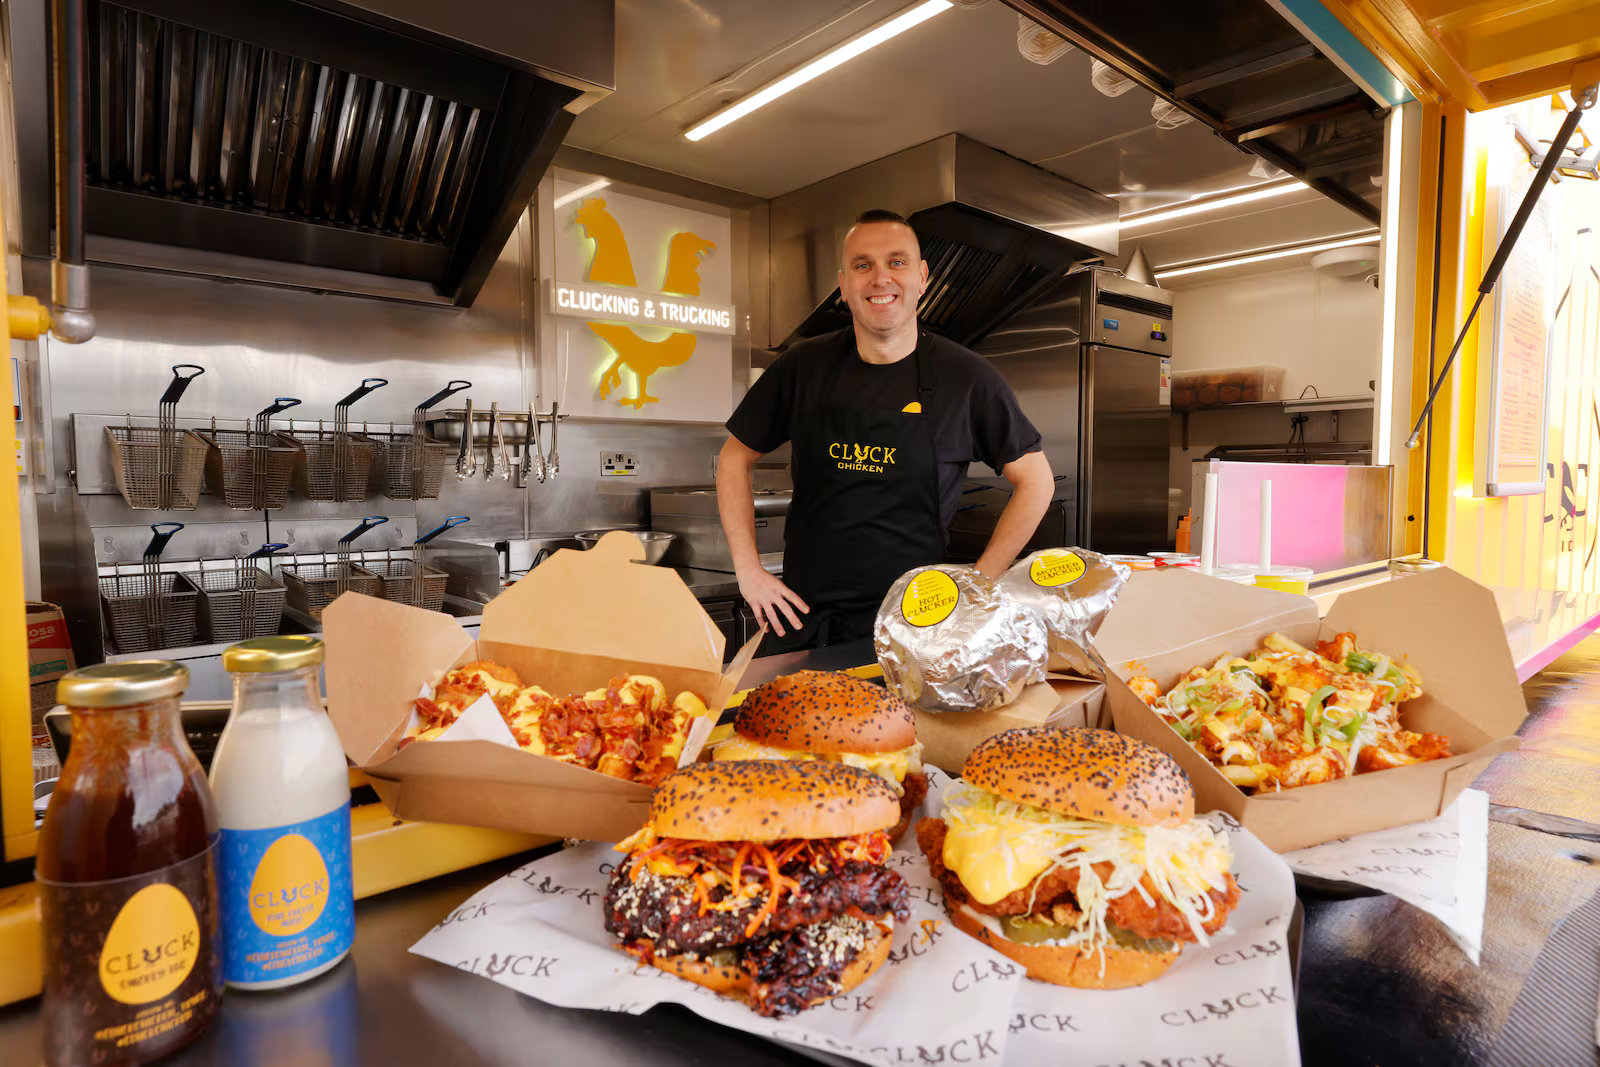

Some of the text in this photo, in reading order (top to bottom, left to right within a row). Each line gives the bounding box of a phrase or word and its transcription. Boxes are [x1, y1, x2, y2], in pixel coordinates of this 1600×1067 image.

[557, 288, 730, 328] CLUCKING & TRUCKING
[829, 442, 897, 465] CLUCK
[837, 462, 884, 474] CHICKEN
[1036, 562, 1079, 577] MOTHER
[1036, 566, 1082, 582] CLUCKER
[907, 596, 955, 618] CLUCKER
[919, 593, 941, 607] HOT
[28, 625, 57, 639] osa
[1370, 846, 1459, 857] CLUC
[1341, 865, 1432, 879] LUCK
[253, 877, 326, 909] CLUCK
[105, 930, 195, 975] CLUCK
[887, 922, 944, 964] UCK
[1213, 938, 1283, 968] CLU
[952, 958, 1018, 993] CLU
[1160, 985, 1288, 1027] CLUCK
[1008, 1013, 1081, 1034] UCK
